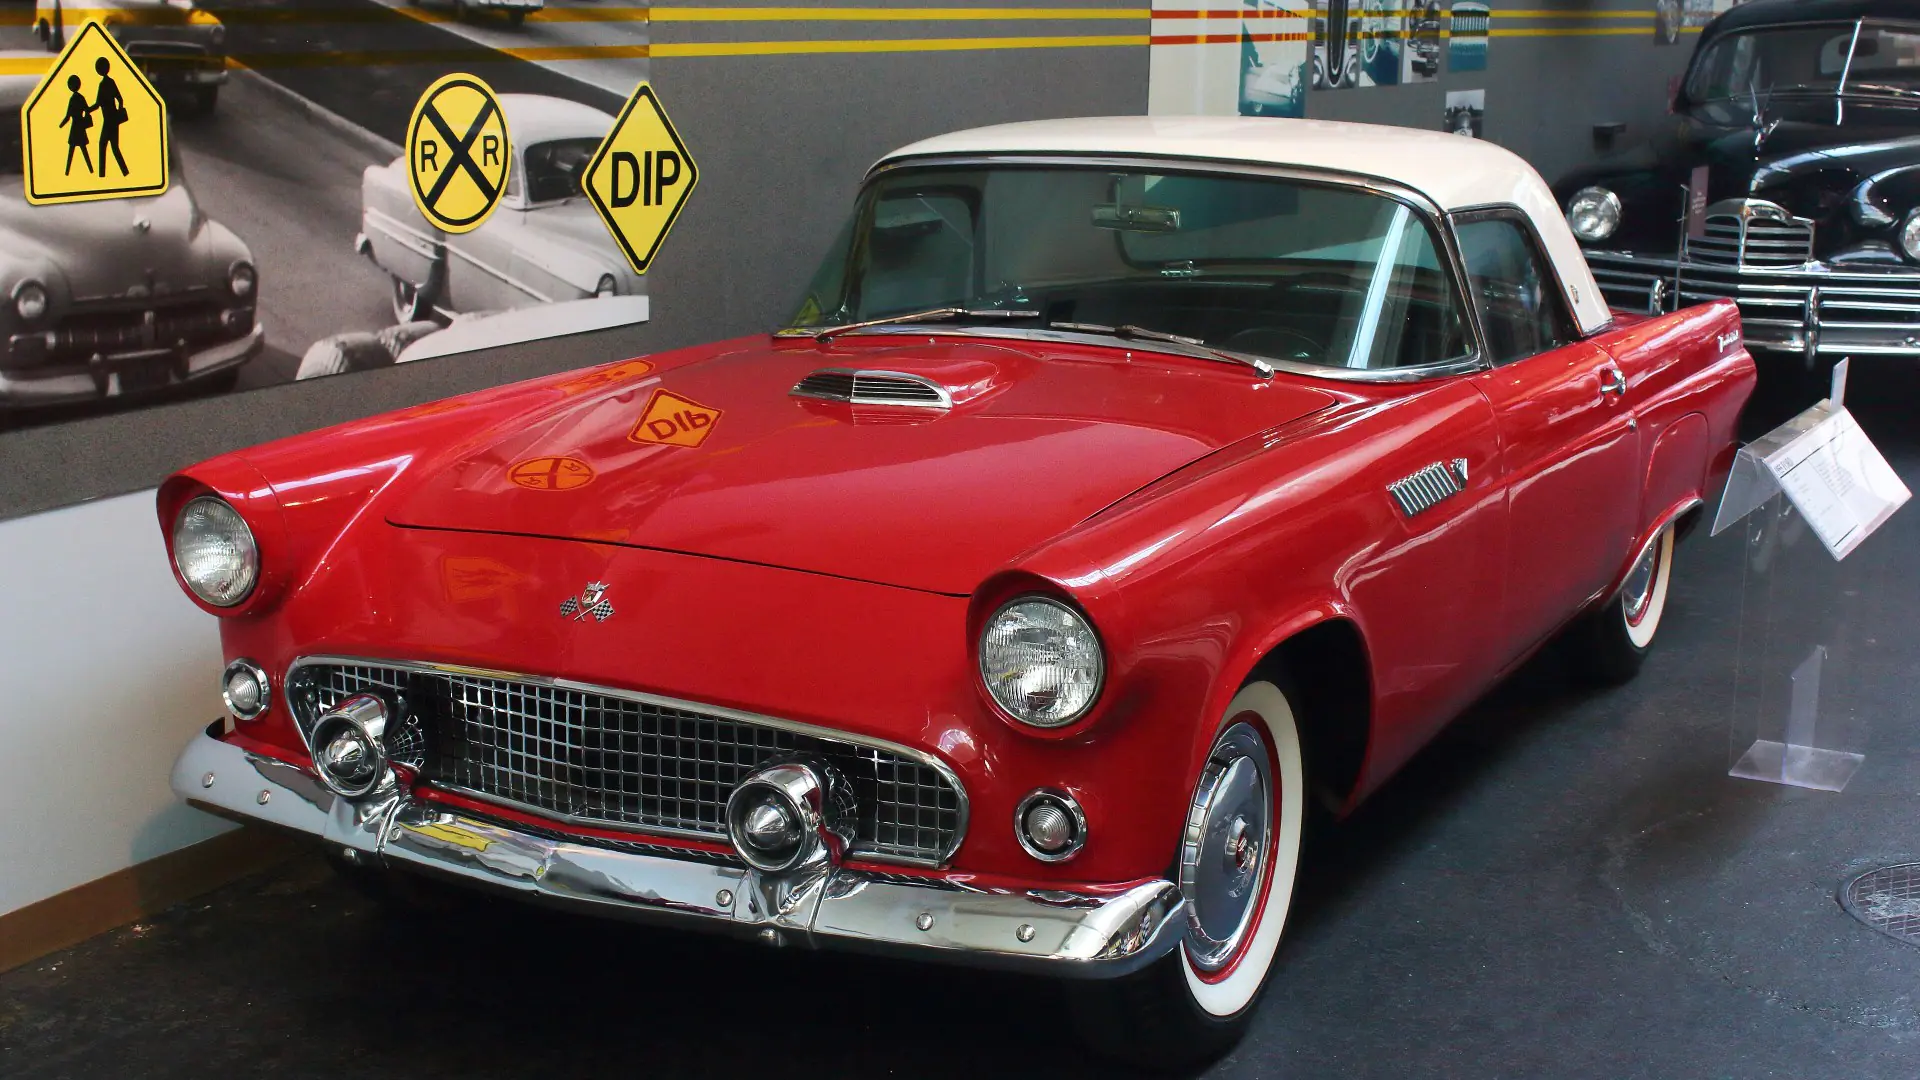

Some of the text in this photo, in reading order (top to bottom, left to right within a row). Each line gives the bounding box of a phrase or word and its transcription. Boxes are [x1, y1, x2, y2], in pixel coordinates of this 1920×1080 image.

[420, 134, 499, 172] R R
[611, 150, 681, 208] DIP
